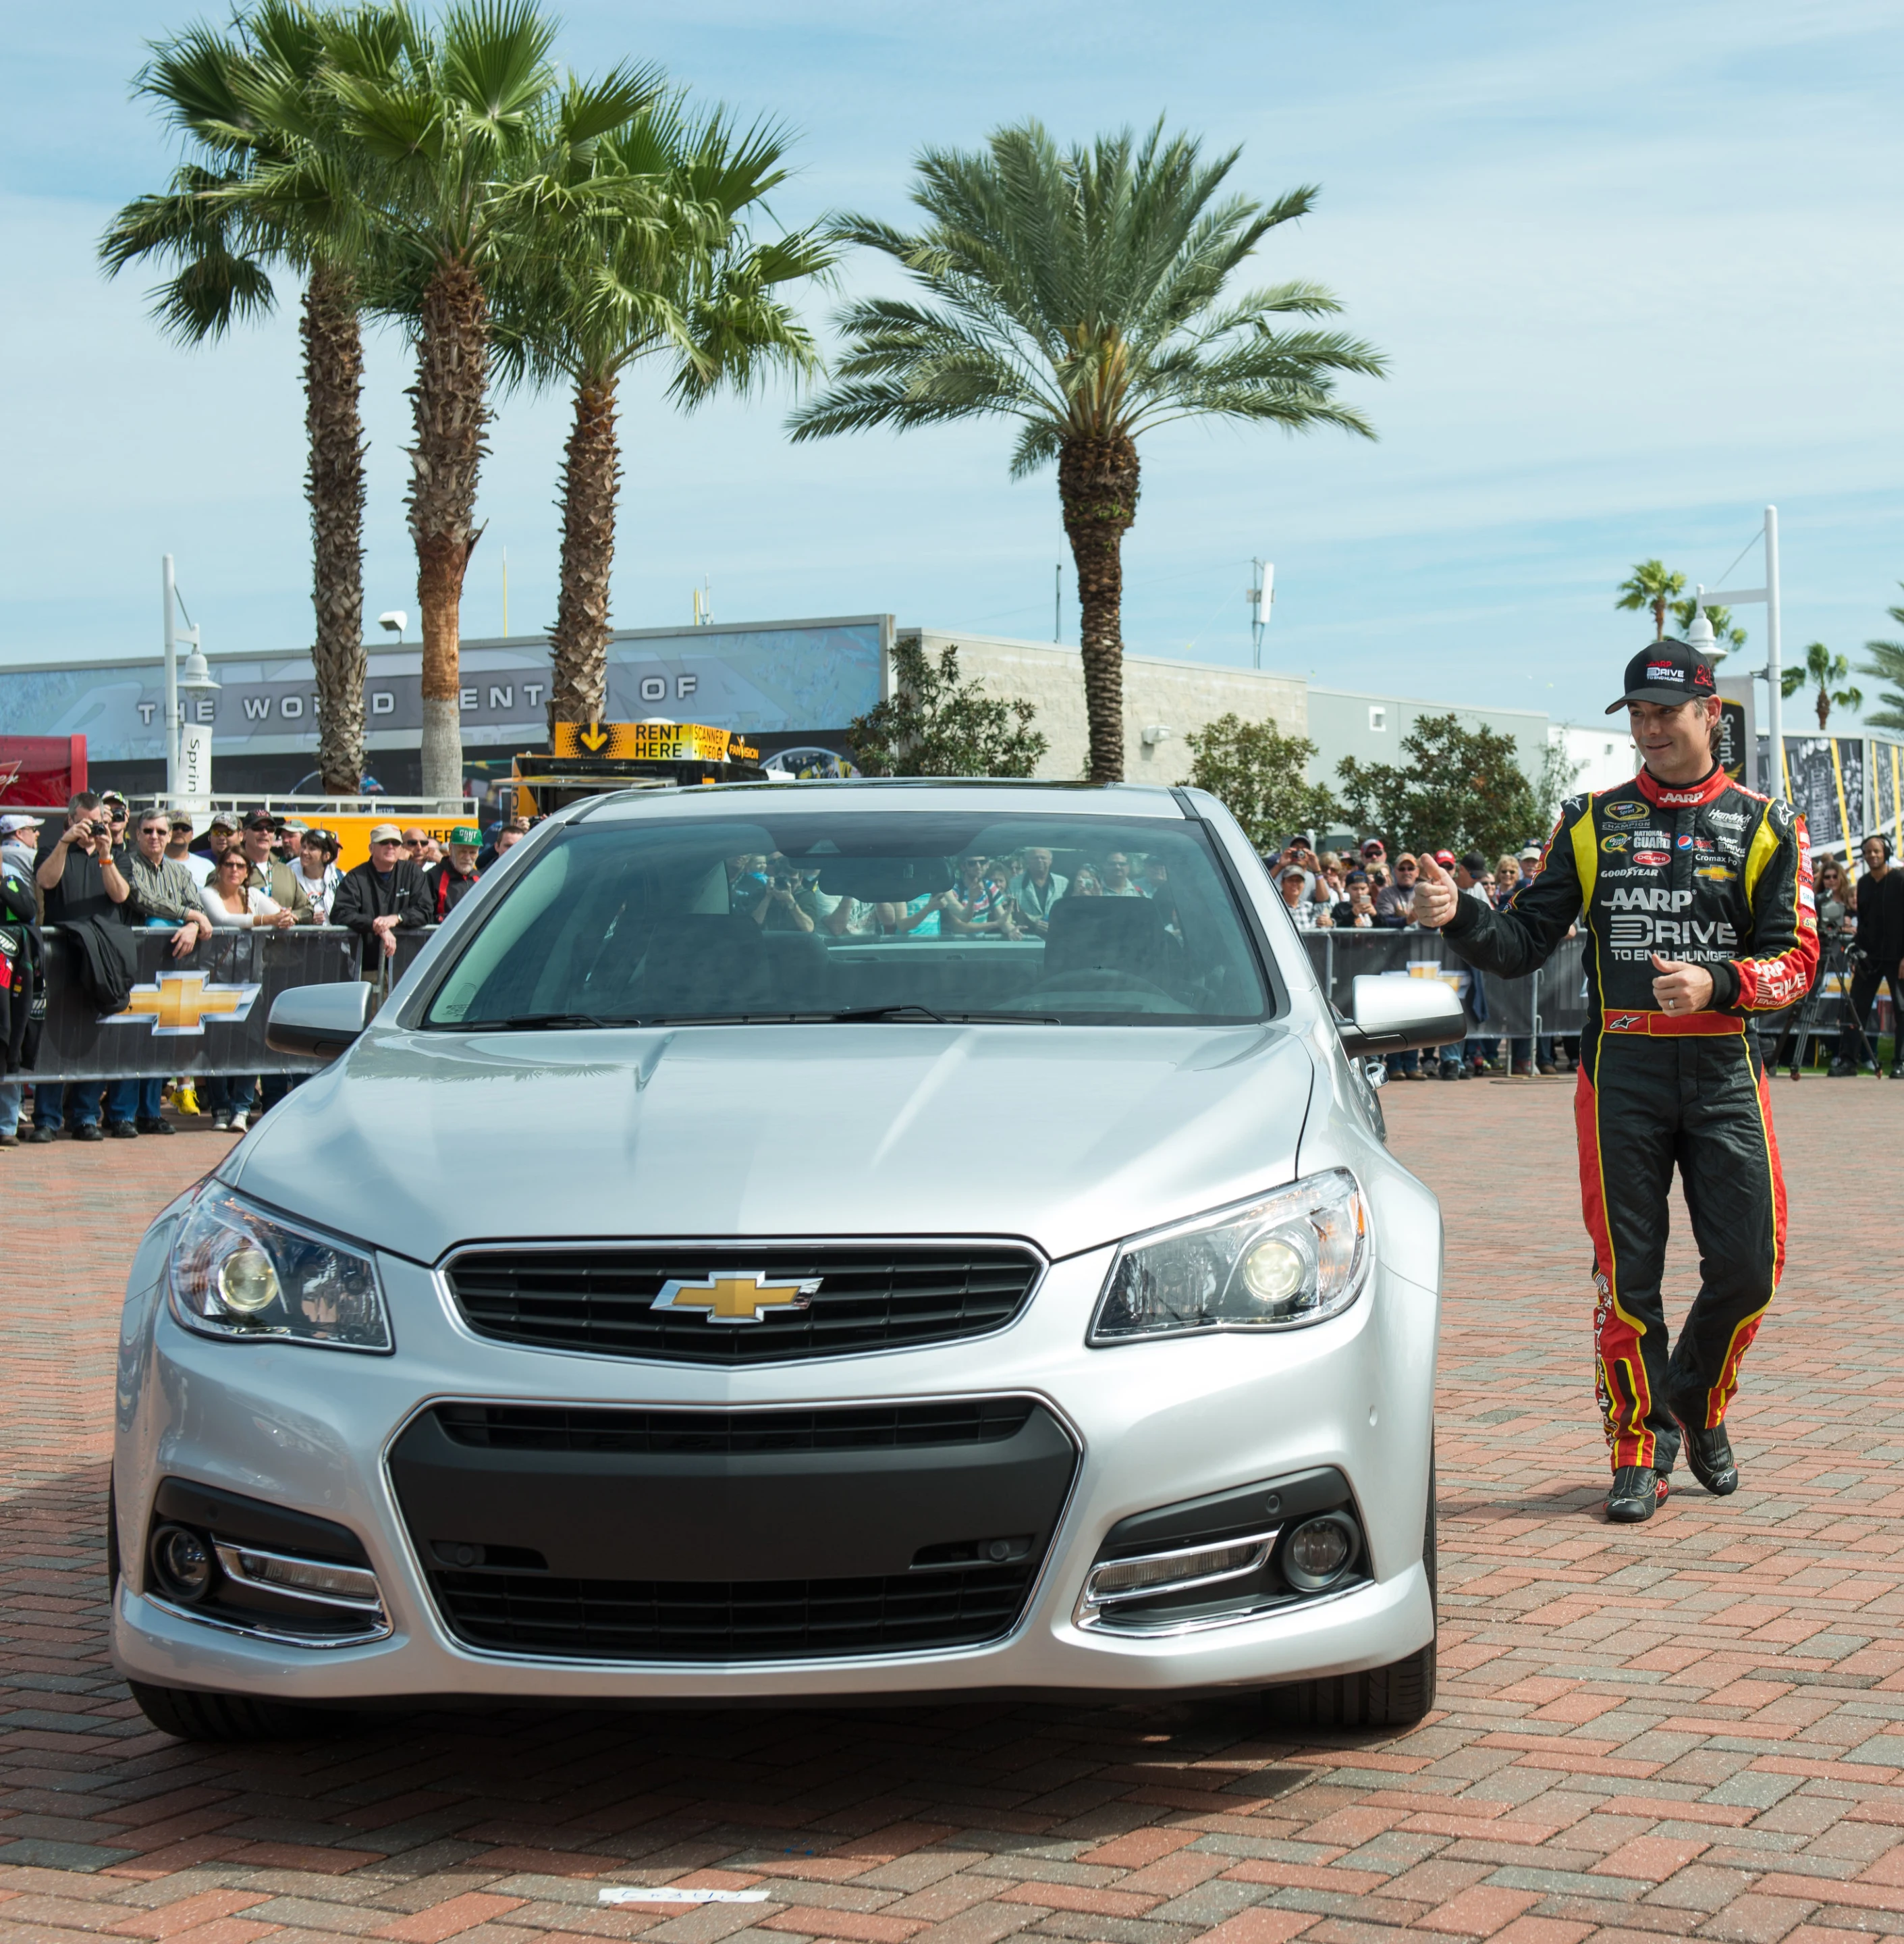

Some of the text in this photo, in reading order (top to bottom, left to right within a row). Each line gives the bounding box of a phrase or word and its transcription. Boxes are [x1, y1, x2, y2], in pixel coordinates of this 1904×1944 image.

[1647, 667, 1685, 678] DRIVE
[1694, 664, 1713, 687] 24
[244, 693, 395, 720] WOD
[641, 676, 697, 701] OF
[635, 725, 684, 740] RENT
[694, 725, 724, 746] SCANNER
[635, 742, 682, 758] HERE
[186, 738, 200, 804] Sprin
[1659, 791, 1705, 803] AARP
[1708, 808, 1752, 825] Hendrick
[1602, 821, 1651, 830] CHAMPION
[1633, 836, 1671, 849] GUARD
[1716, 835, 1739, 845] AARP
[1695, 853, 1726, 863] Cromax
[1600, 866, 1658, 878] GOODYEAR
[1600, 887, 1693, 913] AARP
[1609, 914, 1739, 948] DRIVE
[1610, 949, 1632, 961] TO
[1633, 949, 1670, 962] END
